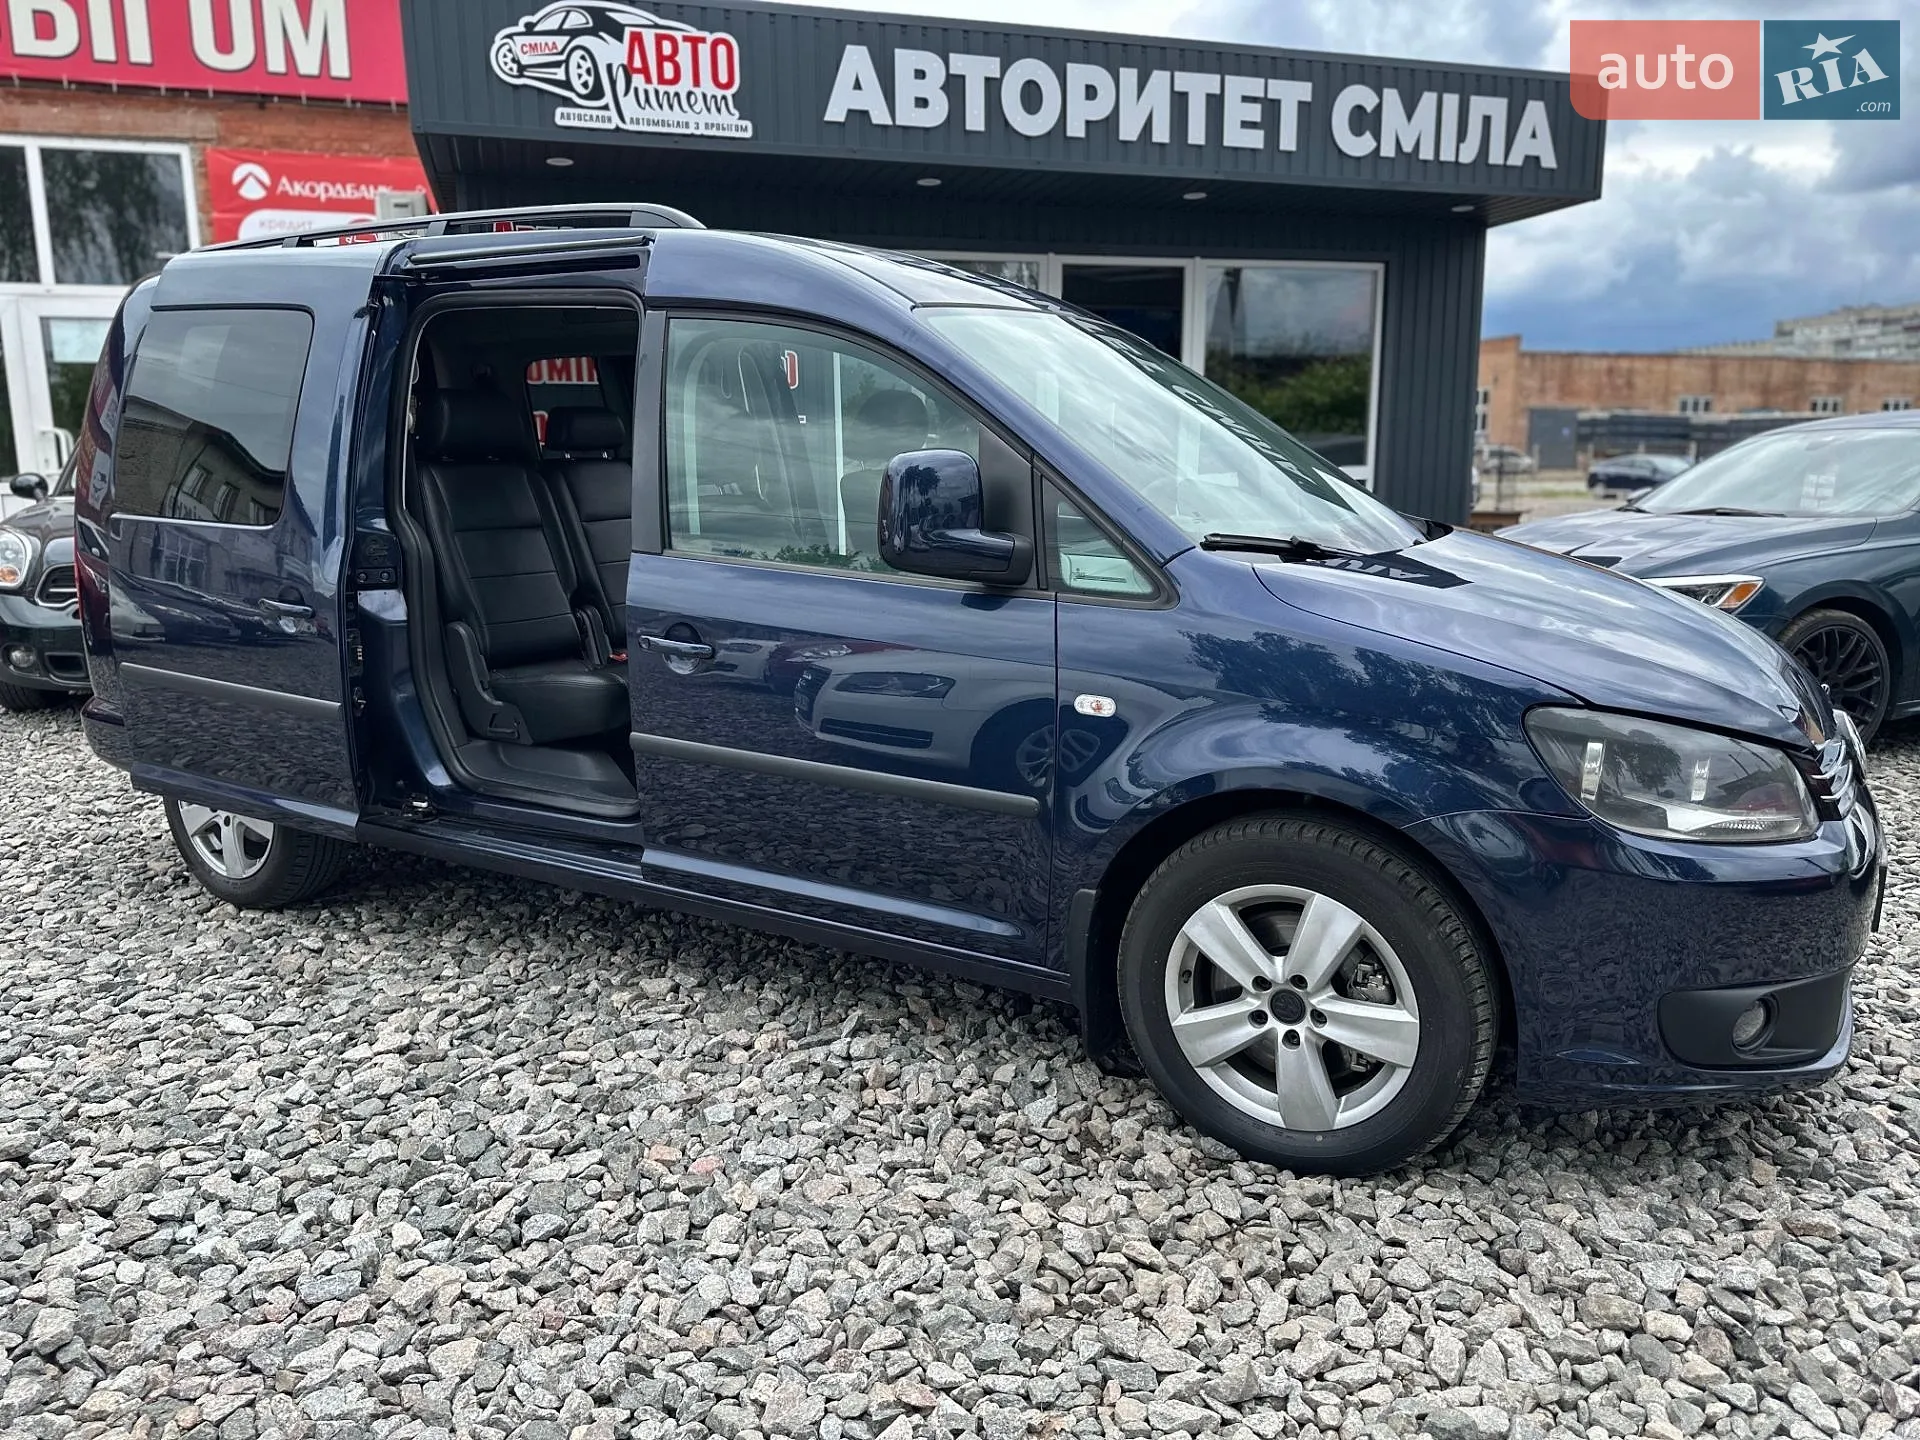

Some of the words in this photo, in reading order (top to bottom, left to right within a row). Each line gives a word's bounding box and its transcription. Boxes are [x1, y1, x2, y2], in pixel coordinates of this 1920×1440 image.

[520, 40, 560, 55] СМІЛА
[627, 30, 736, 91] АВТО
[559, 111, 613, 124] АВТОСАЛОН
[823, 43, 1312, 151] АВТОРИТЕТ
[1331, 83, 1558, 169] СМІЛА
